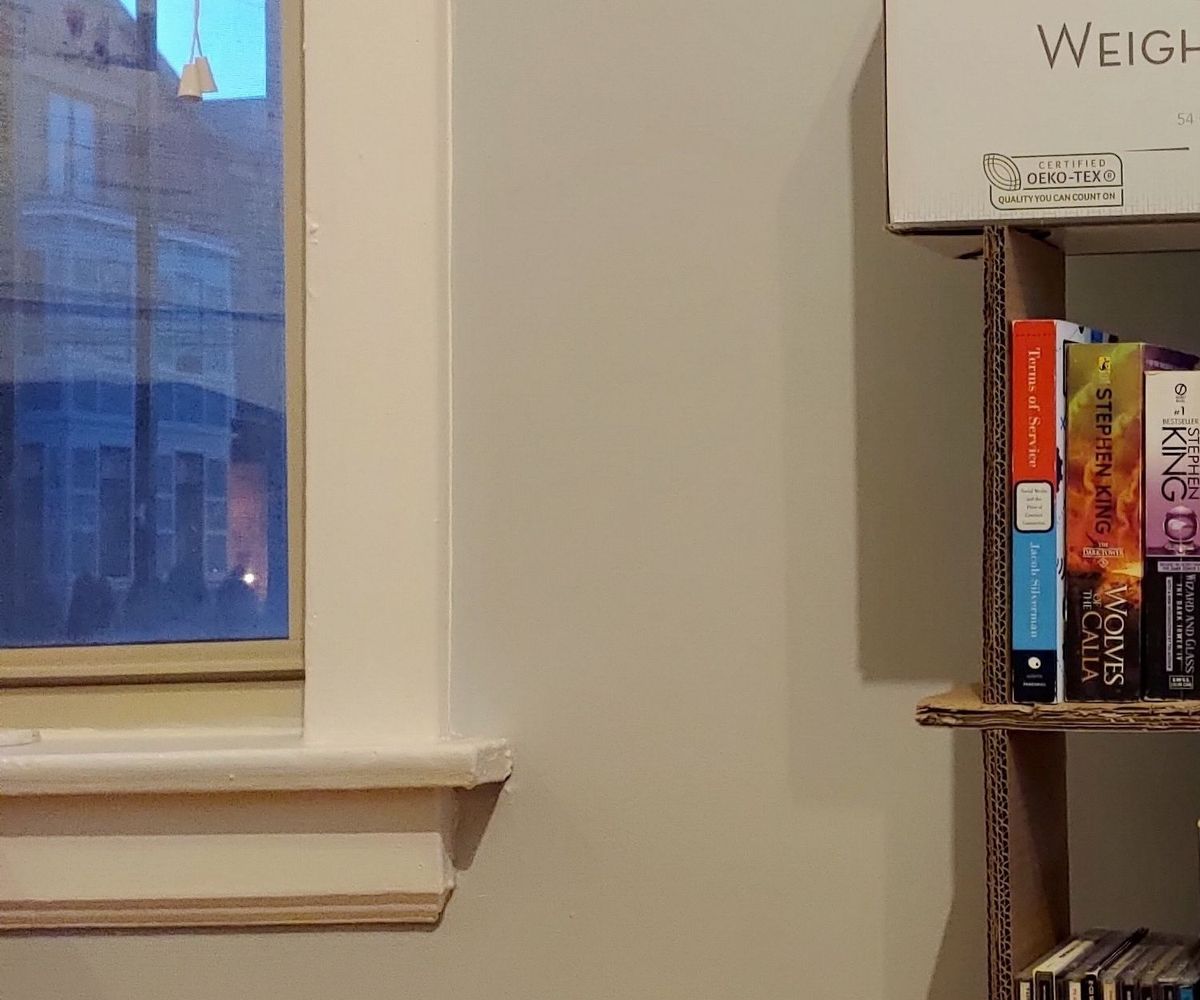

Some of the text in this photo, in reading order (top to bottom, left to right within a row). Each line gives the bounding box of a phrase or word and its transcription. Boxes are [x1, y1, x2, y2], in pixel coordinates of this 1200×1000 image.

[1177, 112, 1194, 125] 54
[998, 192, 1116, 205] QUALITY YOU CAN COUNT ON
[1038, 159, 1106, 170] CERTIFIED
[1028, 347, 1041, 468] Terms of Service
[1095, 387, 1112, 535] STEPHEN KING
[1161, 426, 1188, 503] KING
[1188, 427, 1200, 500] STEPHEN
[1029, 541, 1041, 638] Jacob Silverman
[1082, 590, 1093, 610] THE
[1093, 594, 1102, 608] OF
[1185, 574, 1197, 674] WIZARD AND GLASS
[1081, 611, 1103, 683] CALLA
[1103, 584, 1128, 686] WOLVES
